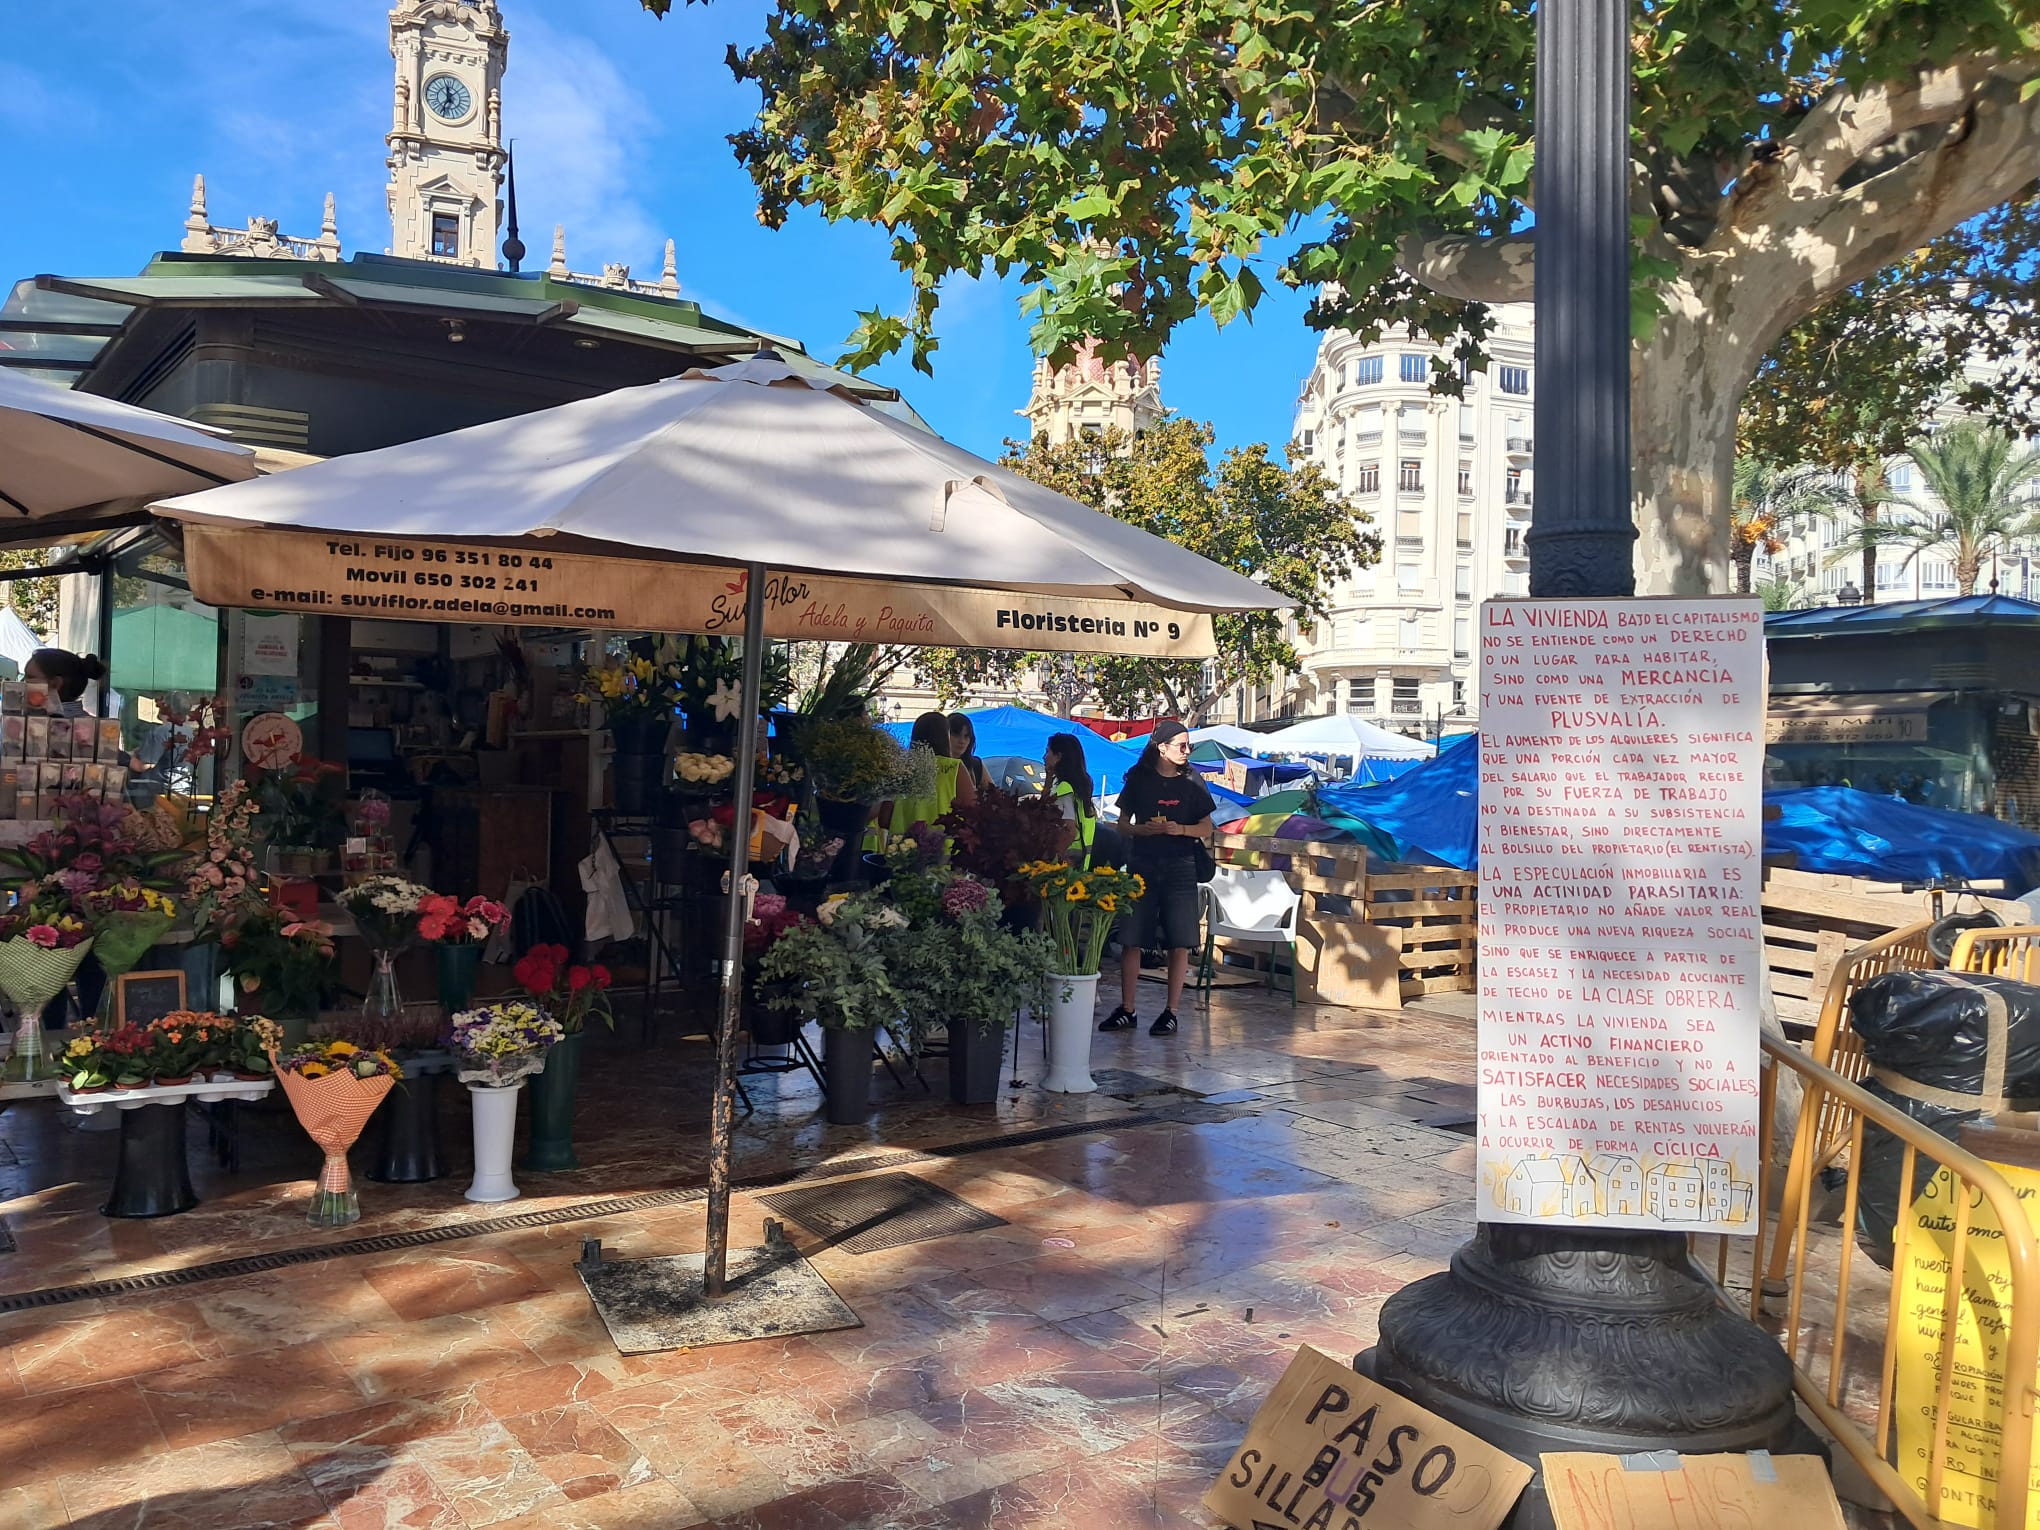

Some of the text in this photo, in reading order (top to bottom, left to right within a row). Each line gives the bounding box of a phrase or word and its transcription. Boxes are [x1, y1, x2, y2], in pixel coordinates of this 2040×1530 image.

[327, 541, 552, 570] Tel. Fijo 96 351 80 44
[346, 568, 538, 592] Movil 650 302 241
[251, 588, 615, 619] e-mail: suviflor.adela@gmail.com
[799, 601, 934, 638] Adela y Paquita
[996, 609, 1125, 636] Floristeria
[1167, 623, 1180, 639] 9
[1490, 608, 1515, 627] LA
[1523, 608, 1608, 629] VIVIENDA
[1618, 612, 1651, 627] BAJO
[1672, 612, 1759, 624] CAPITALISMO
[1483, 629, 1747, 648] NO SE ENTIENDE COMO UN DERECHO
[1494, 664, 1733, 686] SINO COMO UNA MERCANCÍA
[1482, 688, 1740, 708] Y UNA FUENTE DE EXTRACCIÓN DE
[1482, 732, 1753, 748] EL AUMENTO DE LOS ALQUILERES SIGNIFICA
[1483, 750, 1738, 765] QUE UNA PORCIÓN CADA VEZ MAYOR
[1483, 771, 1744, 783] DEL SALARIO QUE EL TRABAJADOR RECIBE
[1503, 786, 1727, 801] POR SU FUERZA DE TRABAJO
[1482, 805, 1745, 819] NO VA DESTINADA A SU SUBSISTENCIA
[1484, 825, 1491, 837] Y
[1582, 826, 1609, 837] SINO
[1624, 827, 1722, 838] DIRECTAMENTE
[1483, 863, 1741, 881] LA ESPECULACIÓN INMOBILIARIA ES
[1493, 886, 1522, 898] UNA
[1533, 885, 1612, 898] ACTIVIDAD
[1481, 903, 1757, 917] EL PROPIETARIO NO AÑADE VALOR REAL
[1482, 924, 1754, 940] NI PRODUCE UNA NUEVA RIQUEZA SOCIAL
[1483, 946, 1735, 964] SINO QUE SE ENRIQUECE A PARTIR DE
[1483, 967, 1745, 985] LA ESCASEZ Y LA NECESIDAD ACUCIANTE
[1484, 987, 1497, 997] DE
[1506, 987, 1548, 998] TECHO
[1558, 989, 1572, 1000] DE
[1583, 987, 1601, 1002] LA
[1606, 988, 1654, 1005] CLASE
[1484, 1010, 1715, 1032] MIENTRAS LA VIVIENDA SEA
[1508, 1033, 1703, 1053] UN ACTIVO FINANCIERO
[1484, 1069, 1586, 1090] SATISFACER
[1597, 1075, 1679, 1091] NECESIDADES
[1501, 1093, 1526, 1107] LAS
[1614, 1098, 1635, 1110] LOS
[1643, 1099, 1723, 1112] DESAHUCIOS
[1480, 1114, 1755, 1136] Y LA ESCALADA DE RENTAS VOLVERÁN
[1482, 1136, 1490, 1148] A
[1499, 1136, 1555, 1150] OCURRIR
[1569, 1138, 1583, 1150] DE
[1595, 1139, 1638, 1153] FORMA
[1305, 1383, 1456, 1496] PASO
